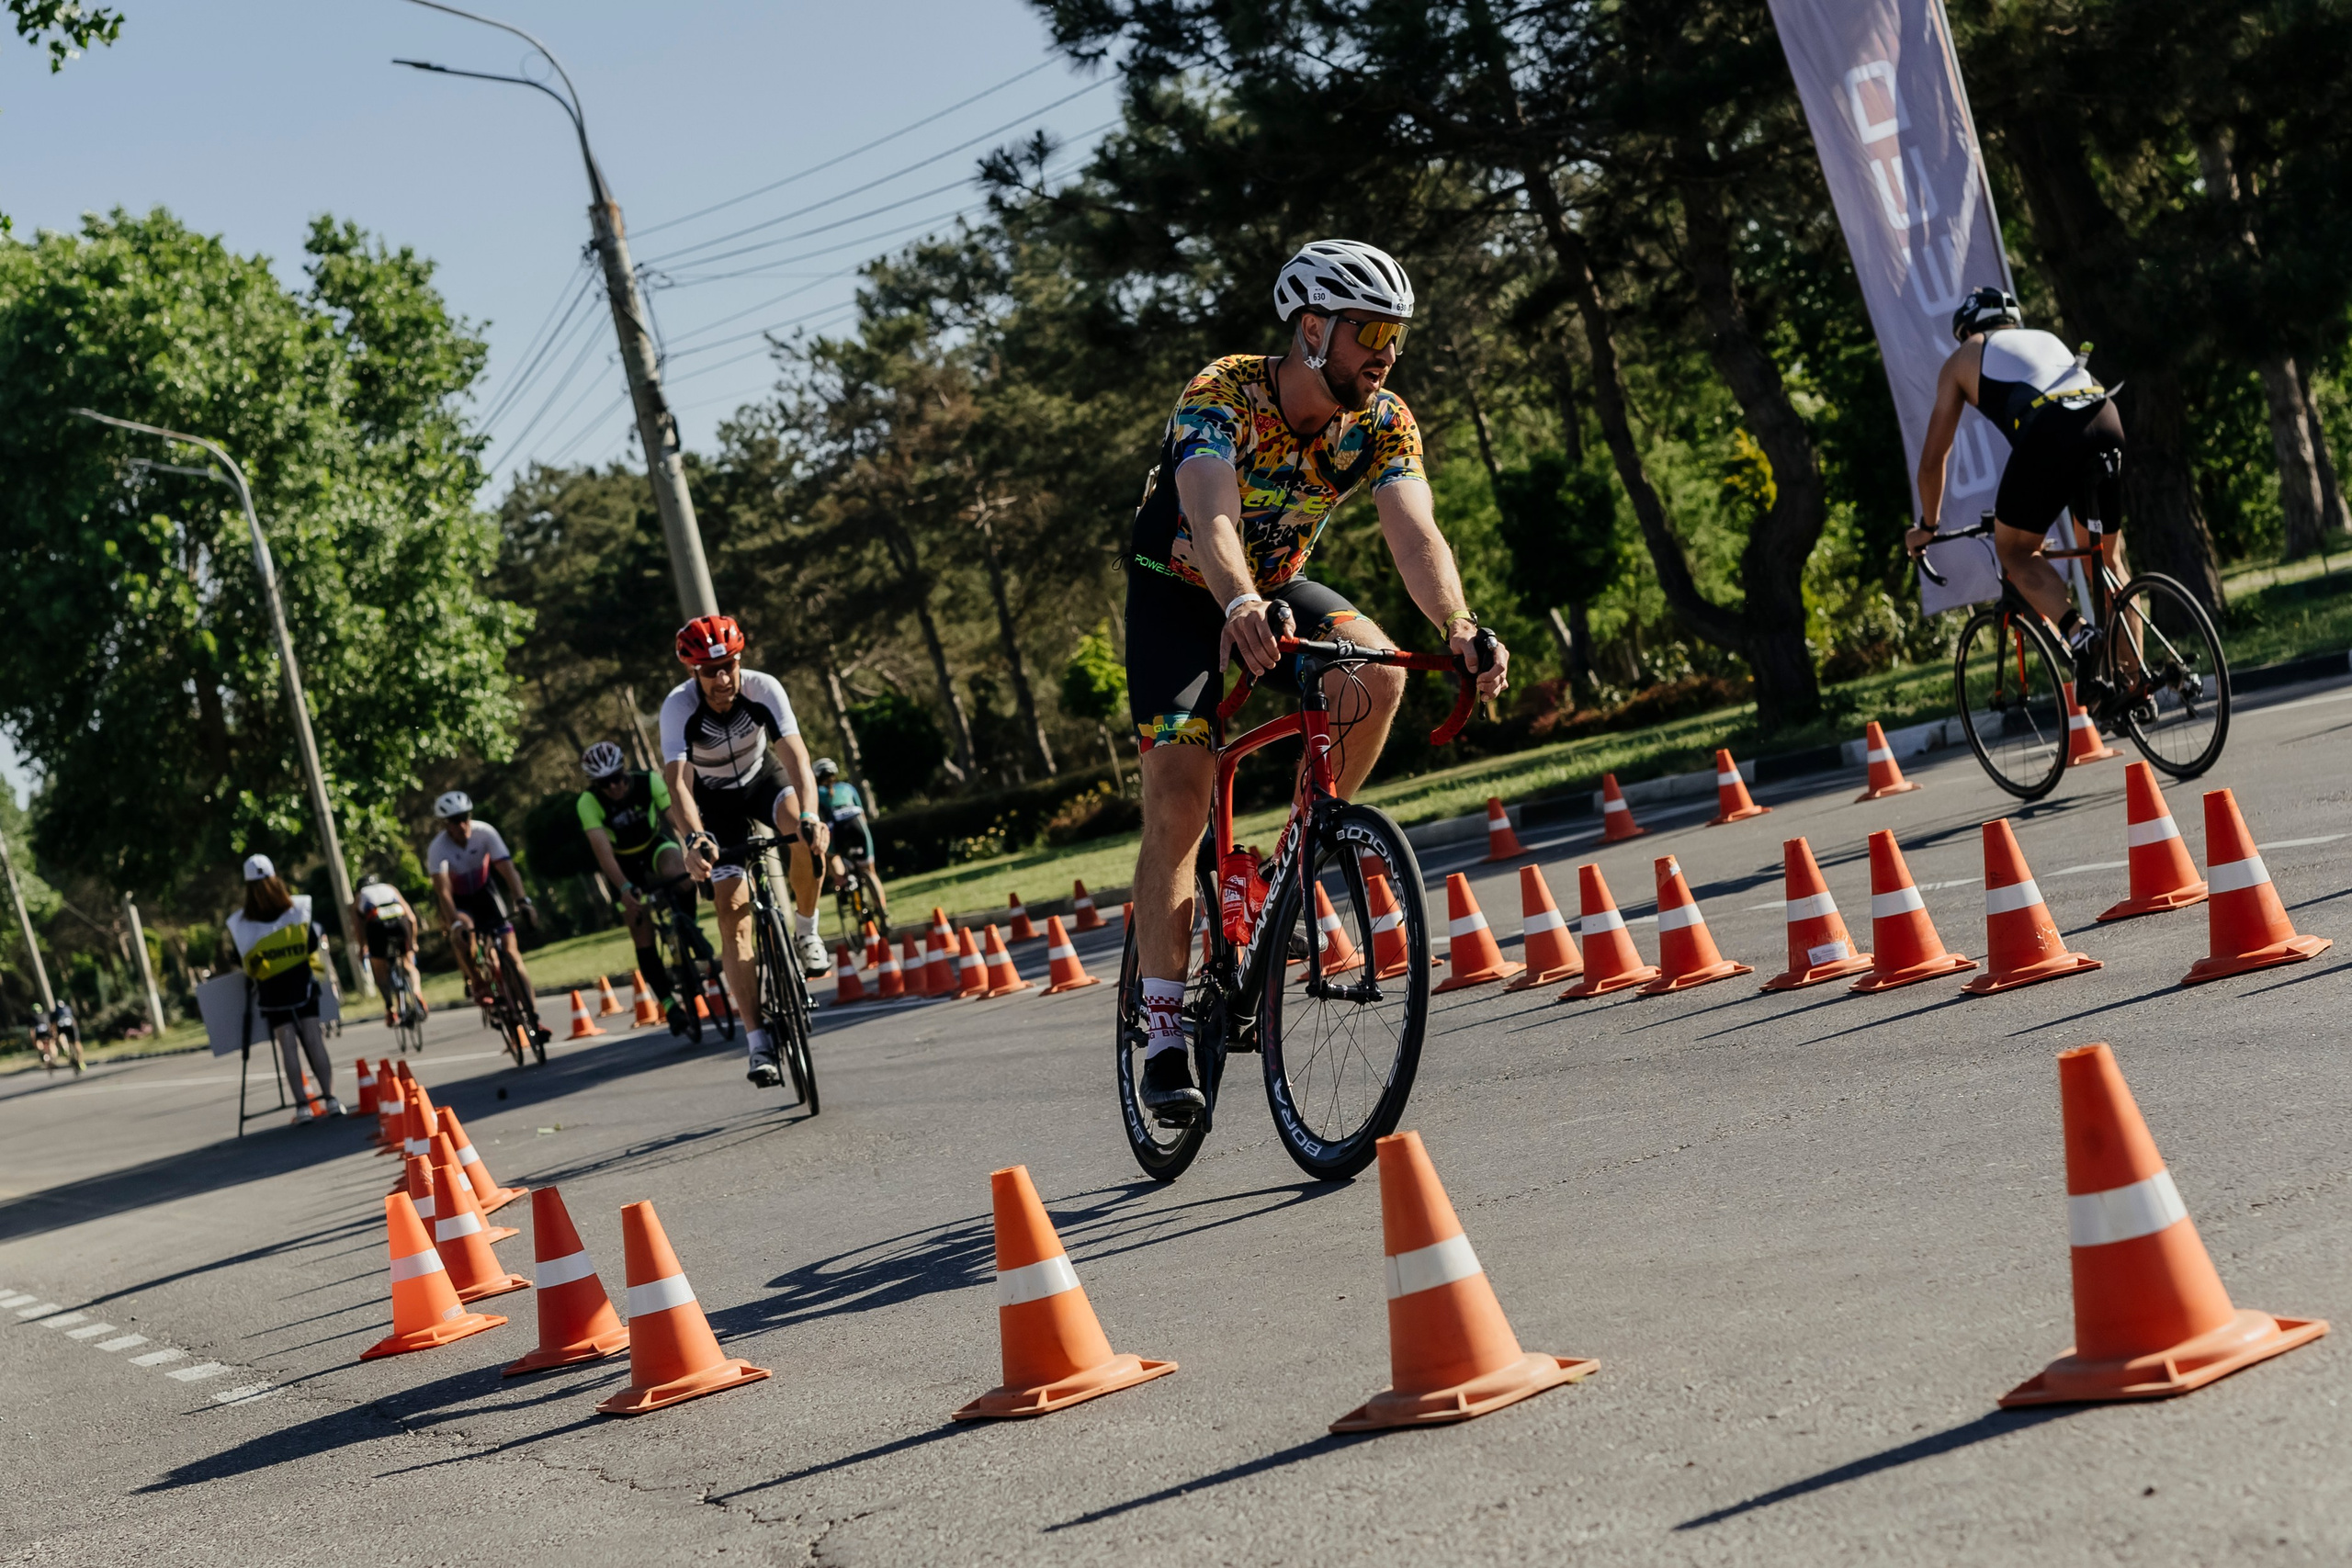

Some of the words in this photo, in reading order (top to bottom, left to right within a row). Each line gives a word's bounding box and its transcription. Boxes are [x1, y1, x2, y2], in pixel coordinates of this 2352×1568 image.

[1313, 292, 1326, 301] 630
[1238, 821, 1299, 990] PINARELLO
[1161, 1029, 1183, 1037] BIC
[1122, 1048, 1146, 1144] BORA
[1273, 1077, 1323, 1157] BORA
